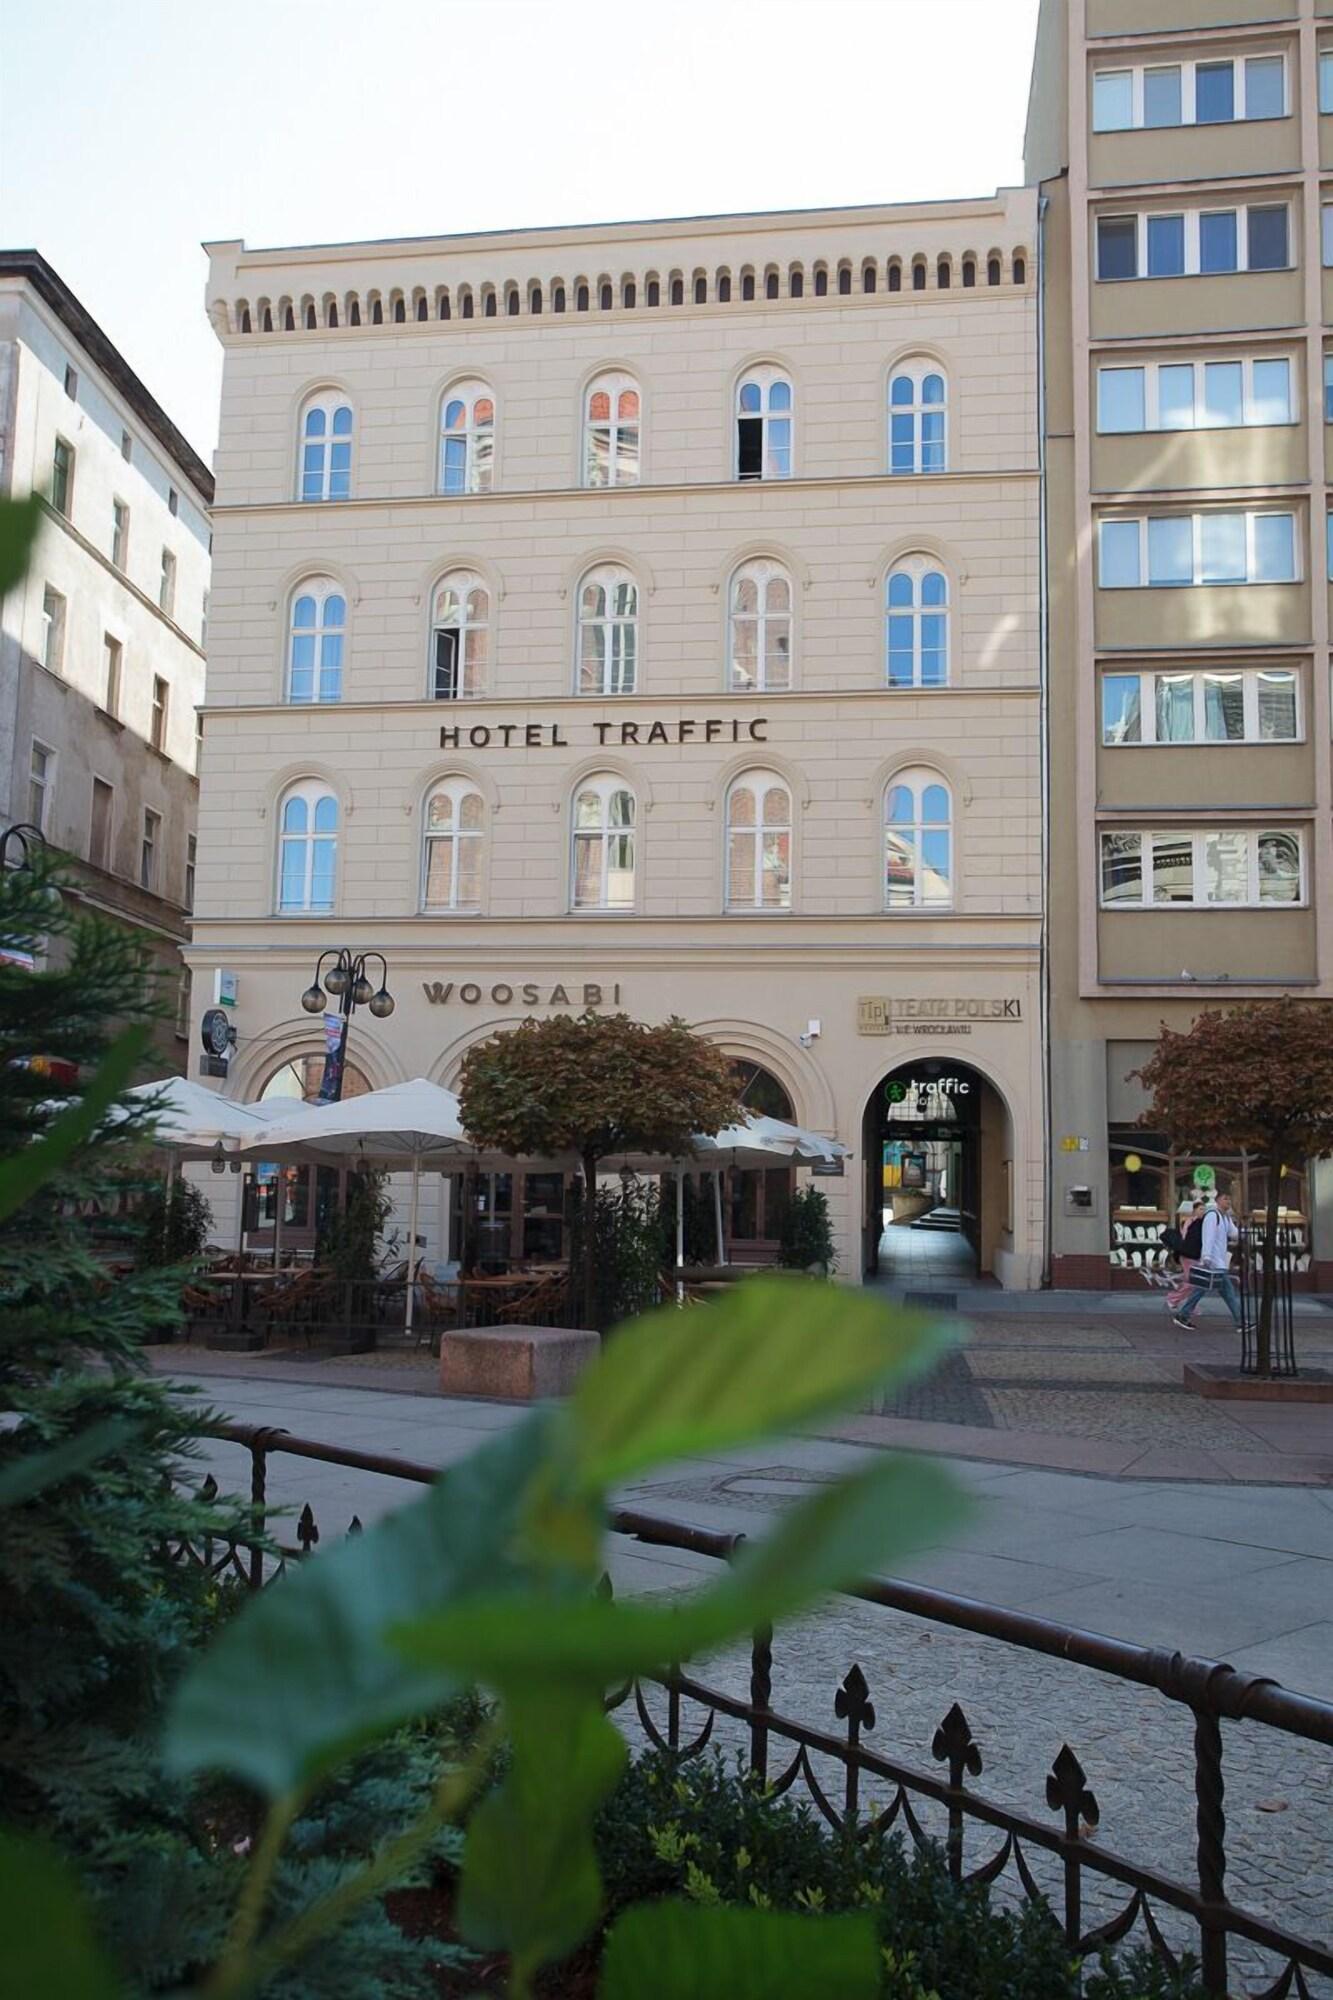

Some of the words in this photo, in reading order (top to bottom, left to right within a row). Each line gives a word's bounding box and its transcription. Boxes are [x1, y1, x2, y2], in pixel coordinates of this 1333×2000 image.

[440, 724, 568, 748] HOTEL
[593, 718, 768, 745] TRAFFIC
[422, 981, 621, 1006] WOOSABI
[896, 999, 949, 1017] TEATR
[955, 999, 1021, 1017] POLSKI
[911, 1077, 970, 1094] traffic
